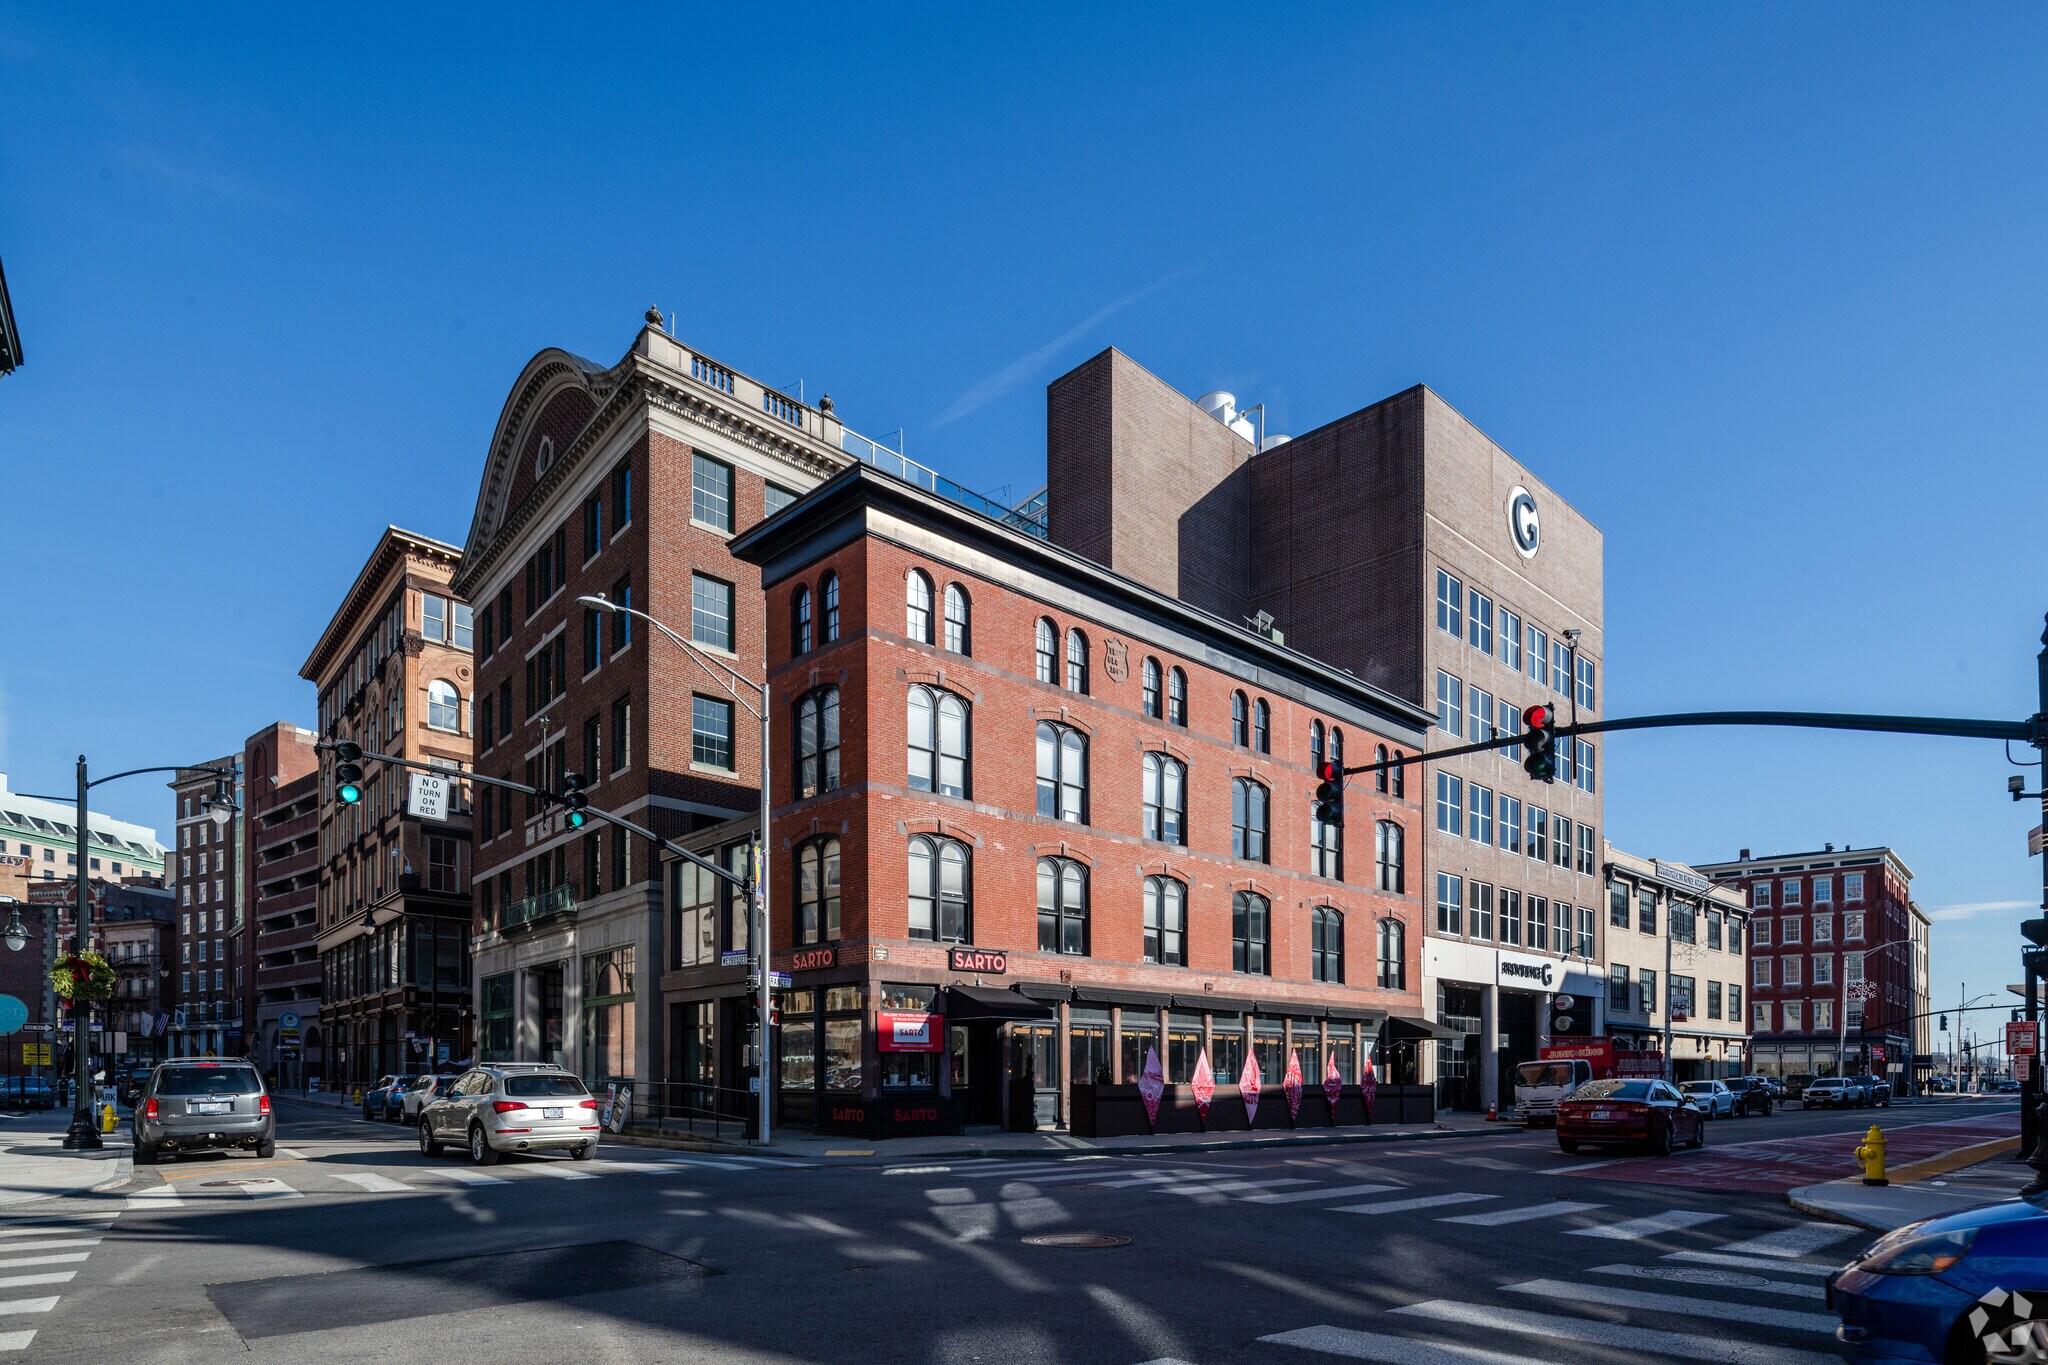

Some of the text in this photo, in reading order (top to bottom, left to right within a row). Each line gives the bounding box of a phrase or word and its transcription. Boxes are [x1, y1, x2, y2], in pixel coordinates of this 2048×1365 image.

[1512, 493, 1537, 551] G
[422, 779, 438, 788] NO
[418, 788, 440, 798] TURN
[422, 798, 435, 806] ON
[419, 806, 436, 815] RED
[723, 955, 747, 966] WEYBOSSET
[794, 951, 833, 969] SARTO
[954, 953, 1004, 970] SARTO
[1502, 962, 1553, 986] PROVIDENCE G
[1547, 1046, 1604, 1060] JUNK KING
[1616, 1058, 1638, 1071] JUNK
[102, 1092, 116, 1102] ARK
[832, 1108, 865, 1121] SARTO
[894, 1108, 938, 1121] SARTO
